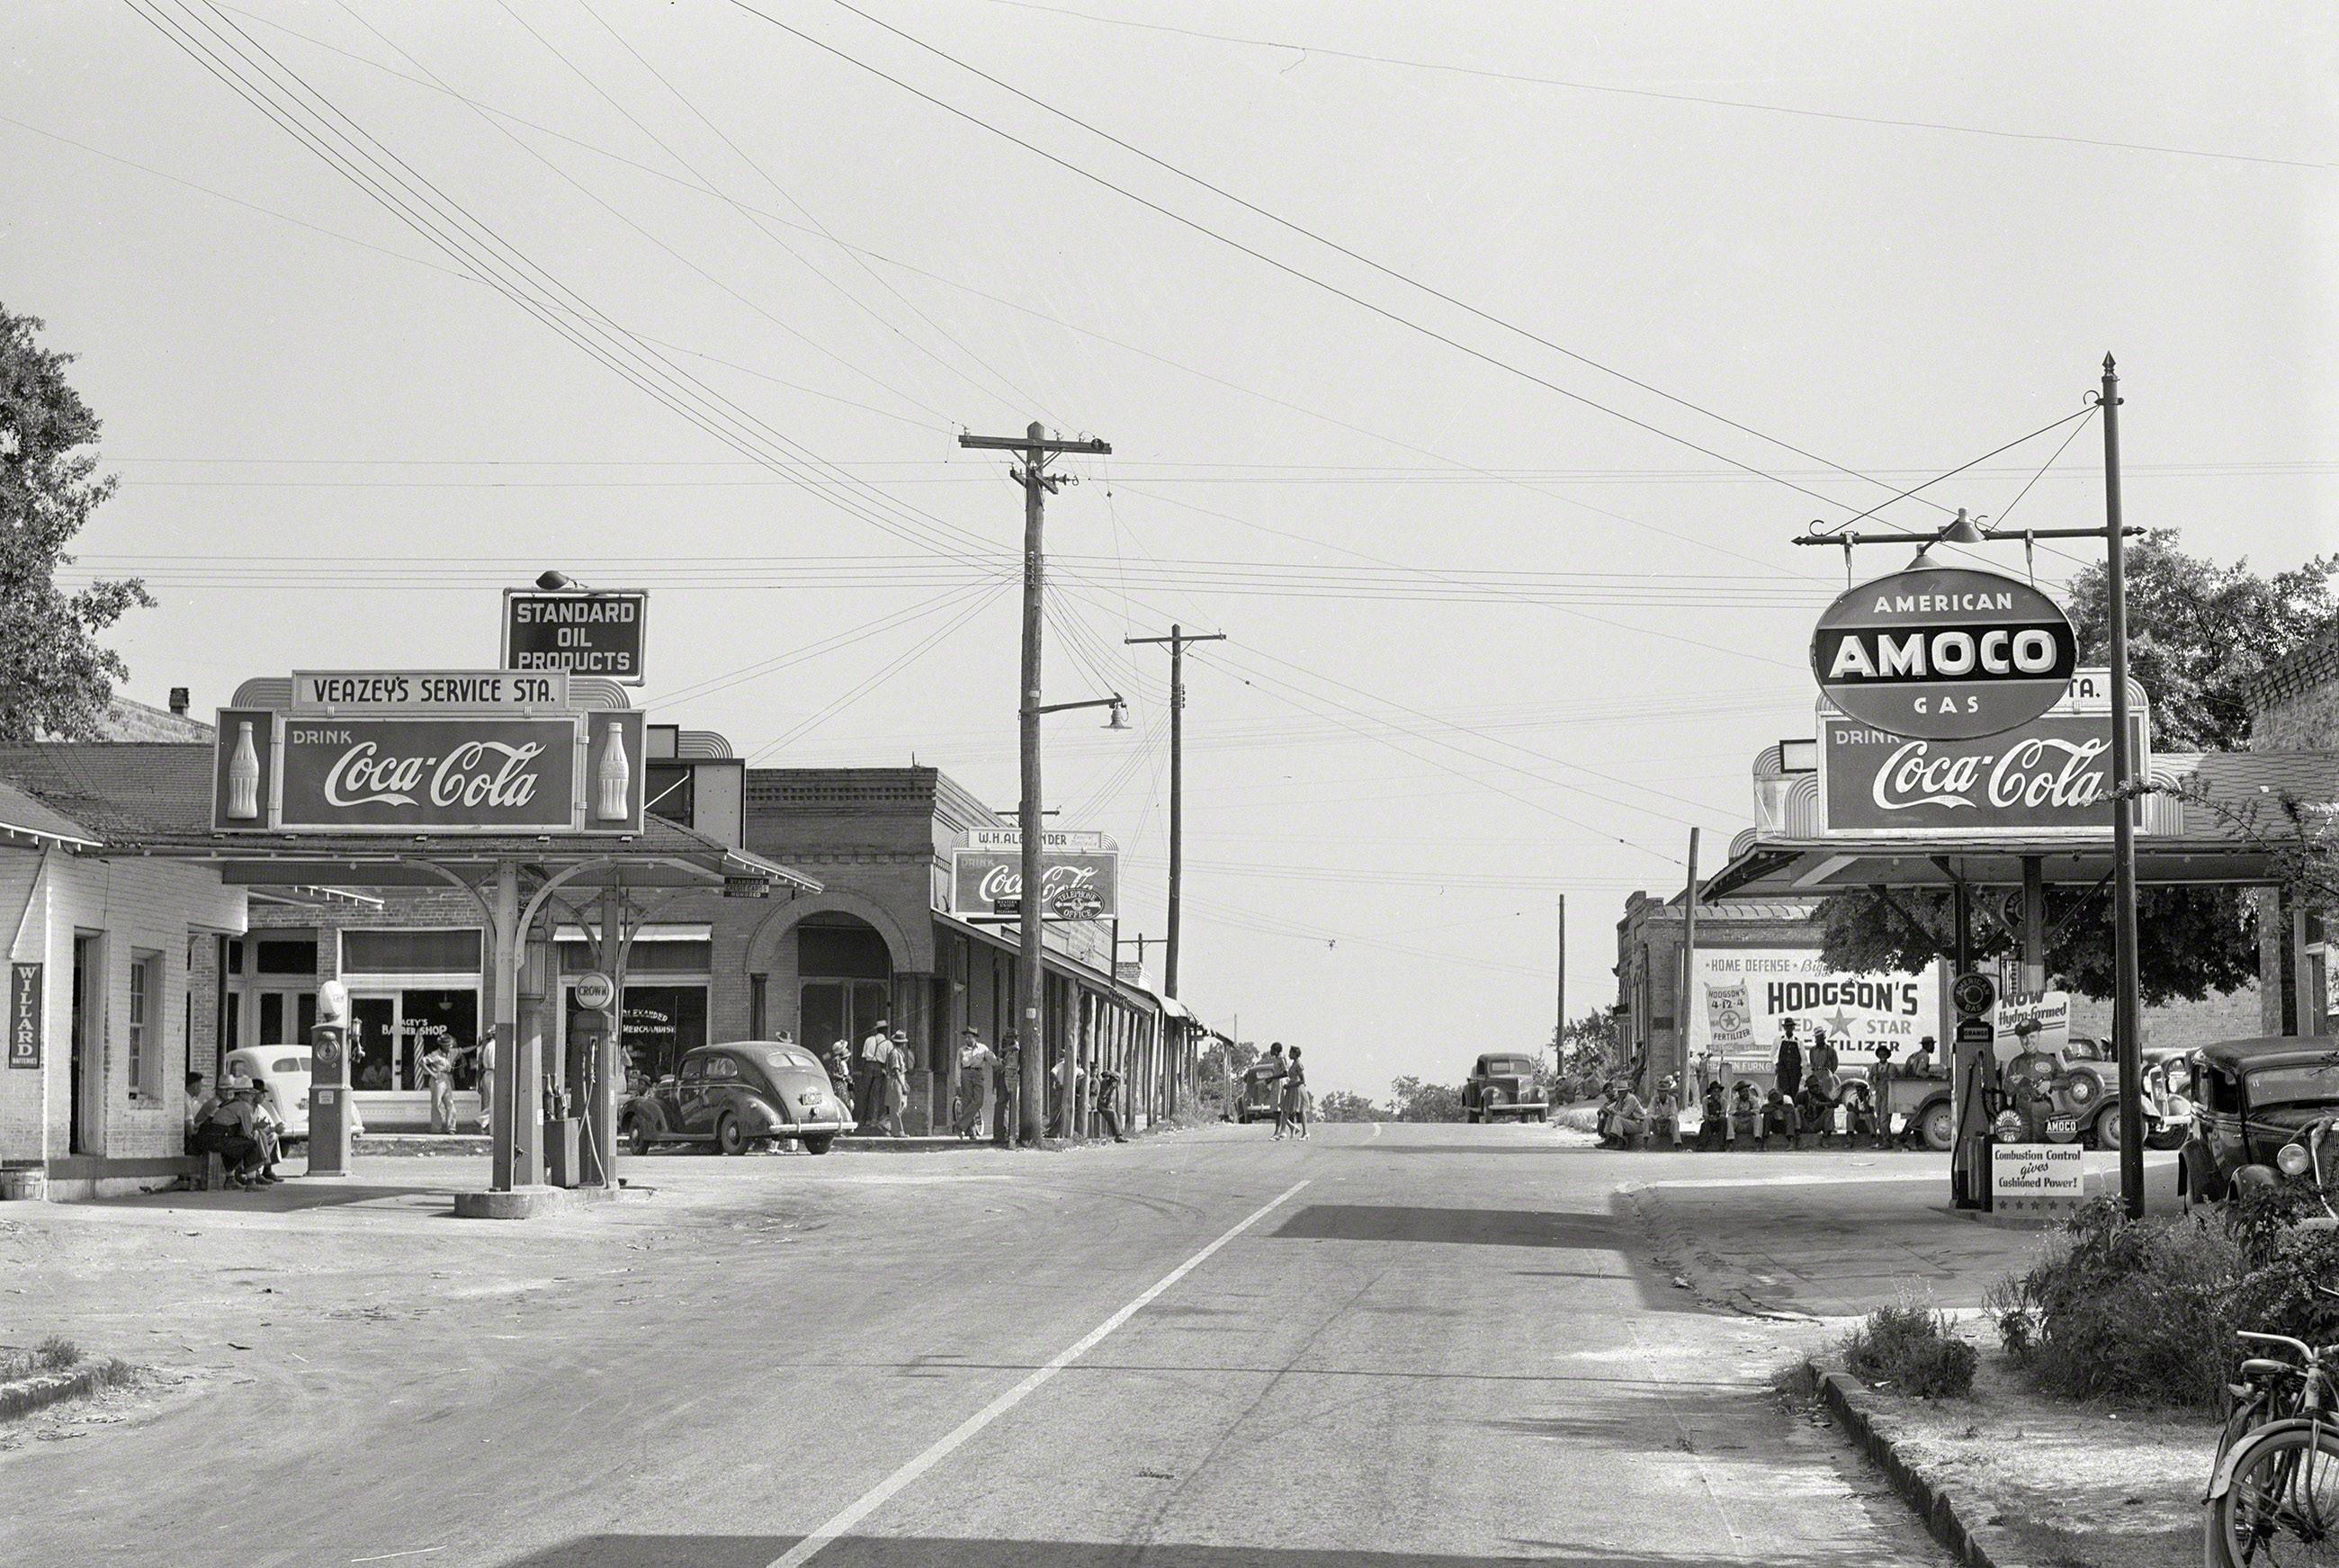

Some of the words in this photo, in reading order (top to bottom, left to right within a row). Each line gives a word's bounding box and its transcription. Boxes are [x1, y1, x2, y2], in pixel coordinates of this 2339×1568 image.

[1873, 592, 2012, 614] AMERICAN
[517, 603, 634, 623] STANDARD
[557, 627, 592, 647] OIL
[518, 652, 630, 670] PRODUCTS
[1828, 629, 2057, 678] AMOCO
[313, 676, 409, 703] VEAZEY'S
[420, 678, 501, 703] SERVICE
[513, 678, 556, 703] STA.
[2069, 678, 2101, 698] TA.
[1913, 696, 1979, 713] GAS
[292, 730, 353, 744] DRINK
[324, 740, 547, 807] Coca-Cola
[1872, 738, 2112, 810] Coca-Cola
[961, 857, 995, 866] DRINK
[1058, 891, 1097, 901] TELEPHONE
[1063, 909, 1092, 918] OFFICE
[1711, 959, 1742, 972] HOME
[1745, 959, 1790, 972] DEFENSE
[578, 986, 608, 996] CROWN
[1708, 988, 1745, 999] HODGSON'S
[1956, 977, 1991, 996] AMERICAN
[1767, 981, 1918, 1016] HODGSON'S
[2002, 990, 2047, 1008] NOW
[17, 966, 36, 1056] WILLARD
[1965, 1004, 1982, 1013] GAS
[419, 1025, 447, 1035] SHOP
[1714, 1028, 1751, 1041] FERTILIZER
[1867, 1019, 1912, 1035] STAR
[1996, 1110, 2021, 1126] AMERICAN
[2047, 1122, 2076, 1131] AMOCO
[1994, 1150, 2043, 1160] Combustion
[2046, 1150, 2081, 1160] Control
[2020, 1162, 2048, 1178] gives
[1998, 1177, 2041, 1187] Cushioned
[2043, 1177, 2077, 1187] Power!
